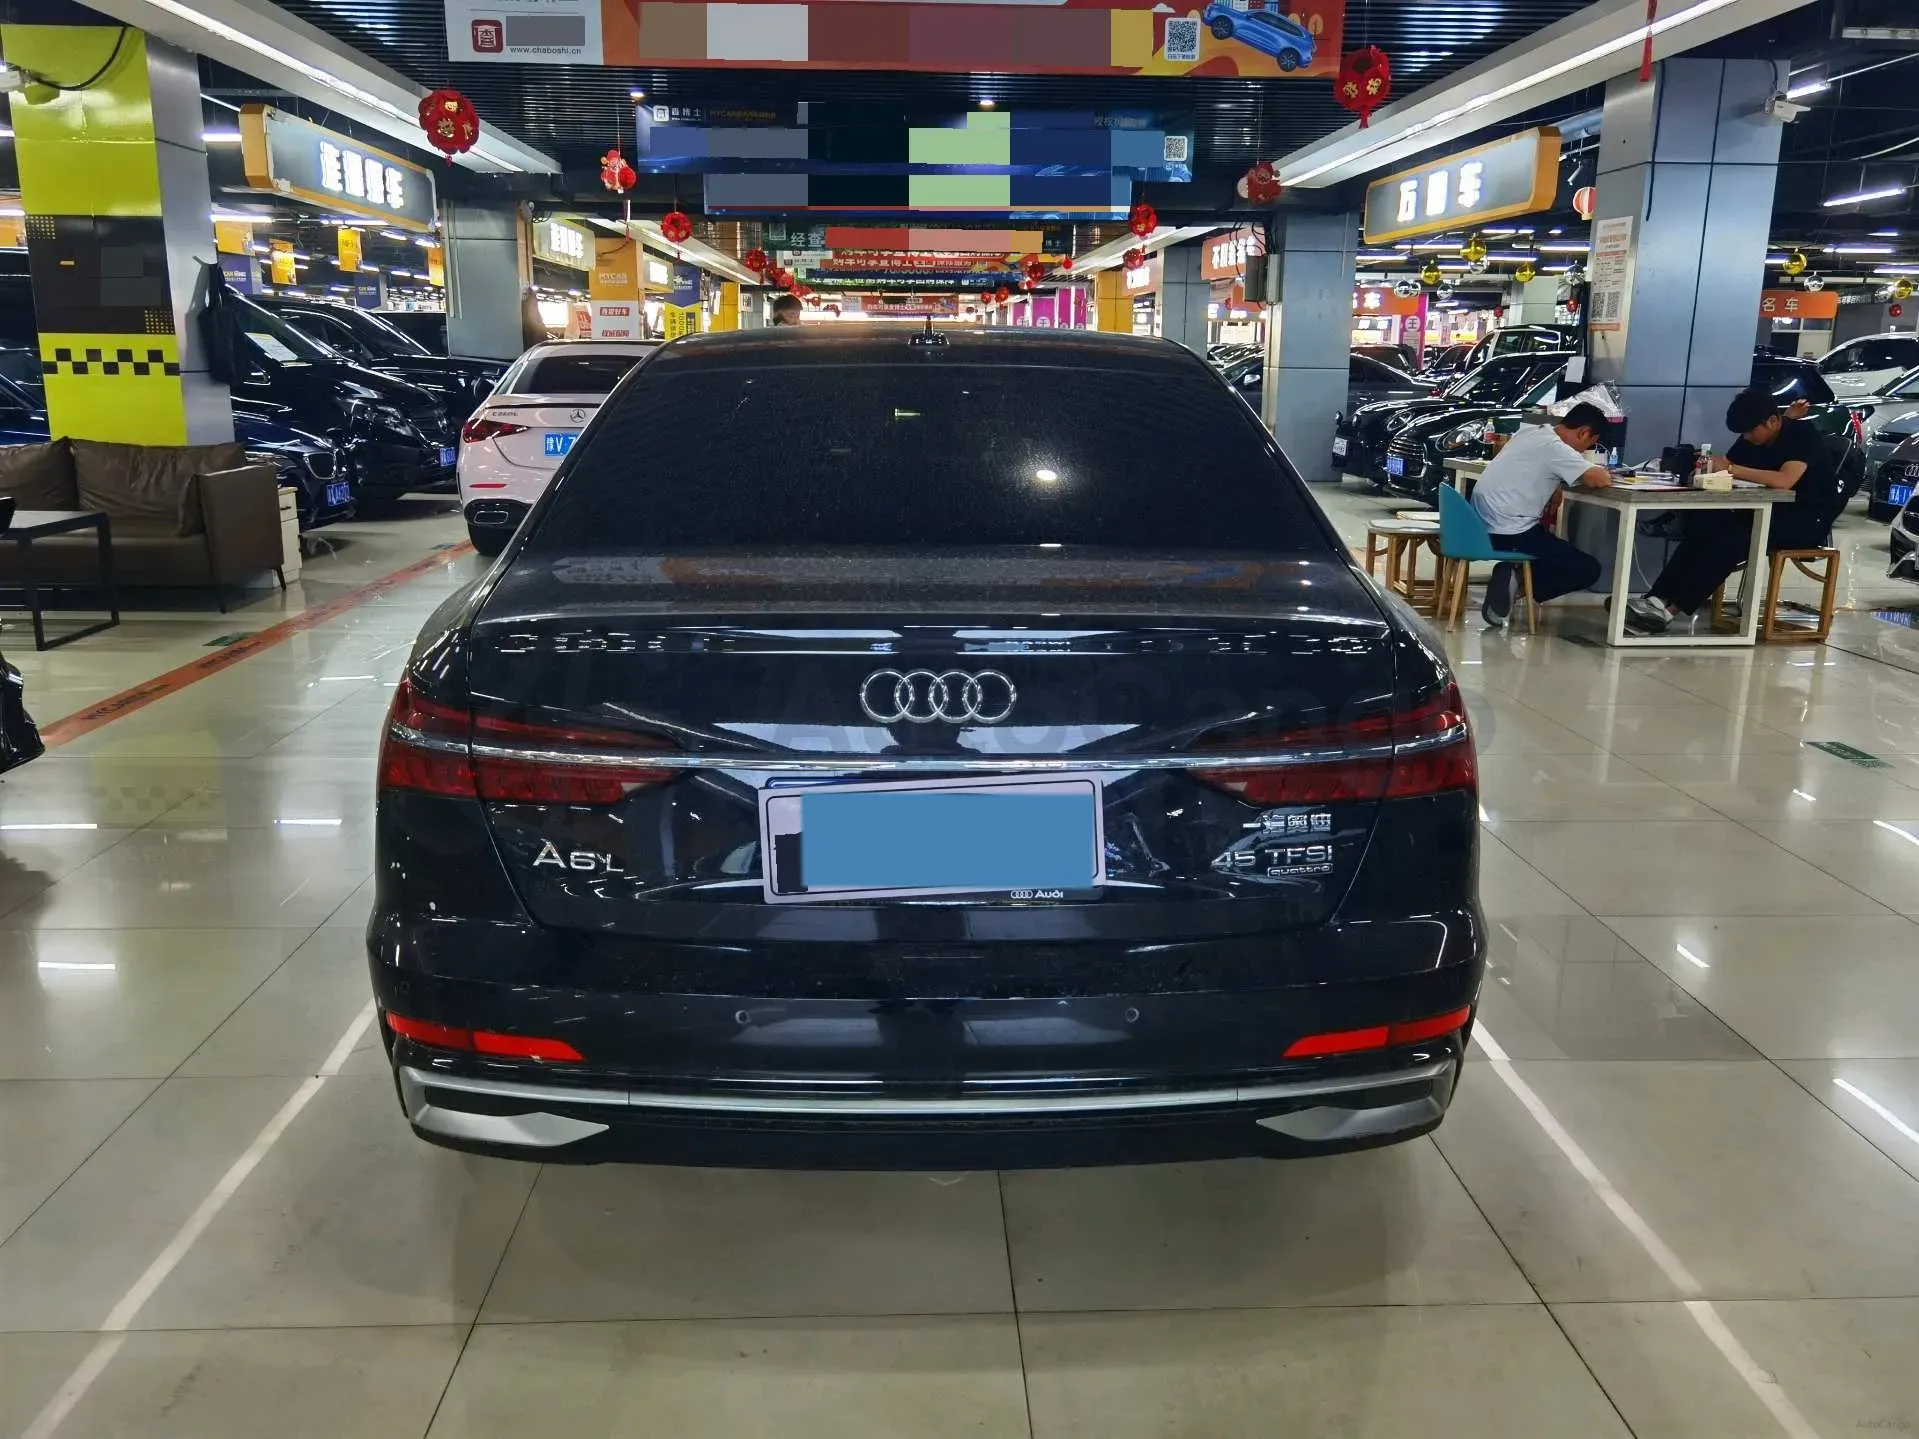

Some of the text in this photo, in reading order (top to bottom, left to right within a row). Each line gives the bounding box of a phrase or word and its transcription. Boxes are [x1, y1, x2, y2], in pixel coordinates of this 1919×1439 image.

[509, 46, 582, 55] www.chaboshi.cn
[533, 839, 624, 872] A6L
[1211, 845, 1333, 867] 45 TFSI
[1269, 865, 1331, 877] quattro
[1035, 889, 1064, 899] Audi
